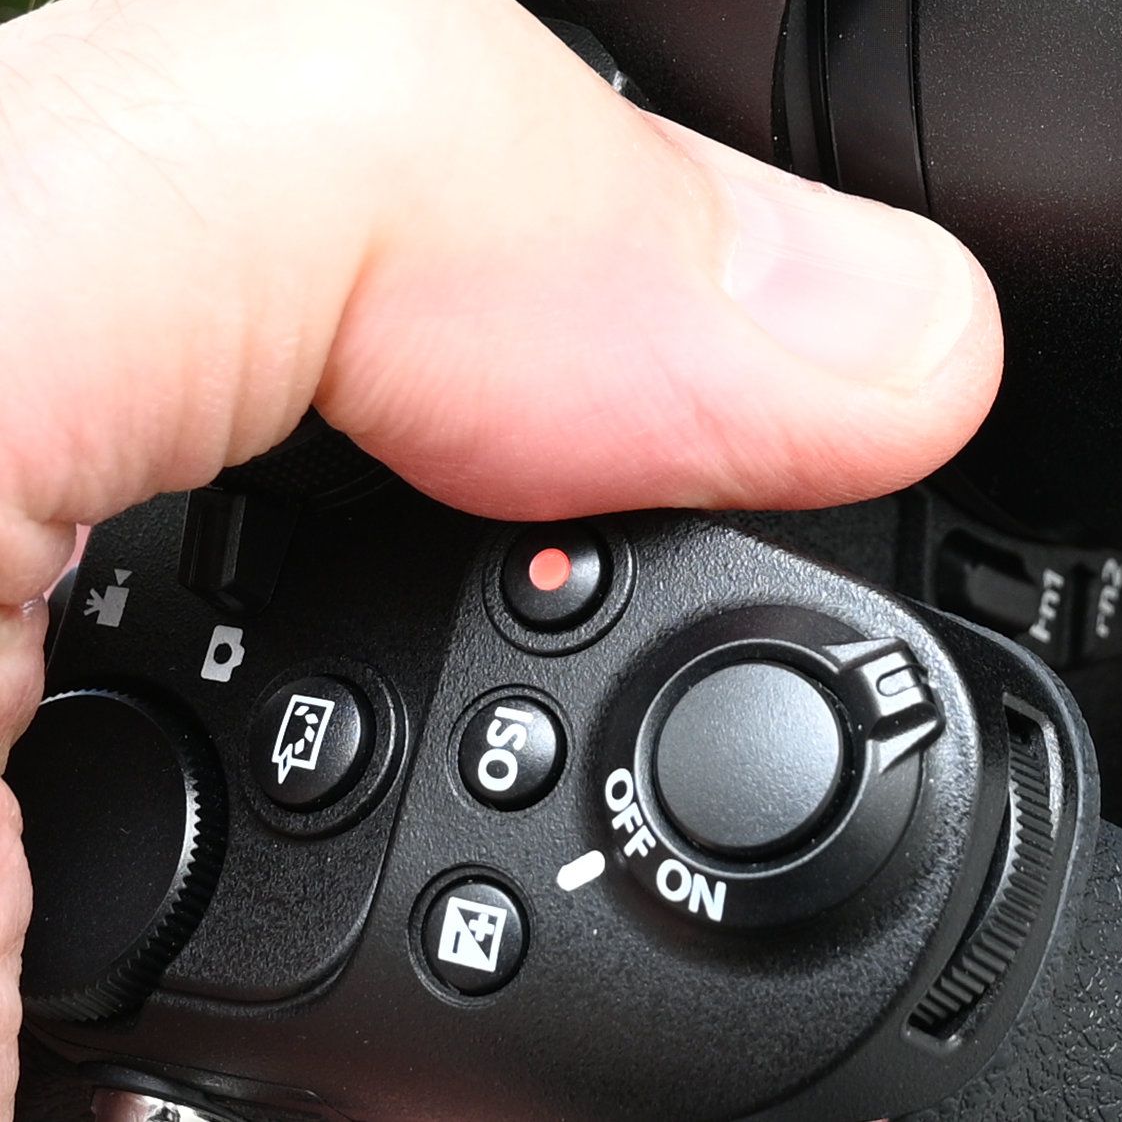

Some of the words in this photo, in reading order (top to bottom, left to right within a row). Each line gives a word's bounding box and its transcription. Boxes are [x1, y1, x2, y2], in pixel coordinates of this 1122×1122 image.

[477, 706, 534, 792] ISO
[604, 767, 657, 858] OFF
[655, 858, 727, 923] ON
